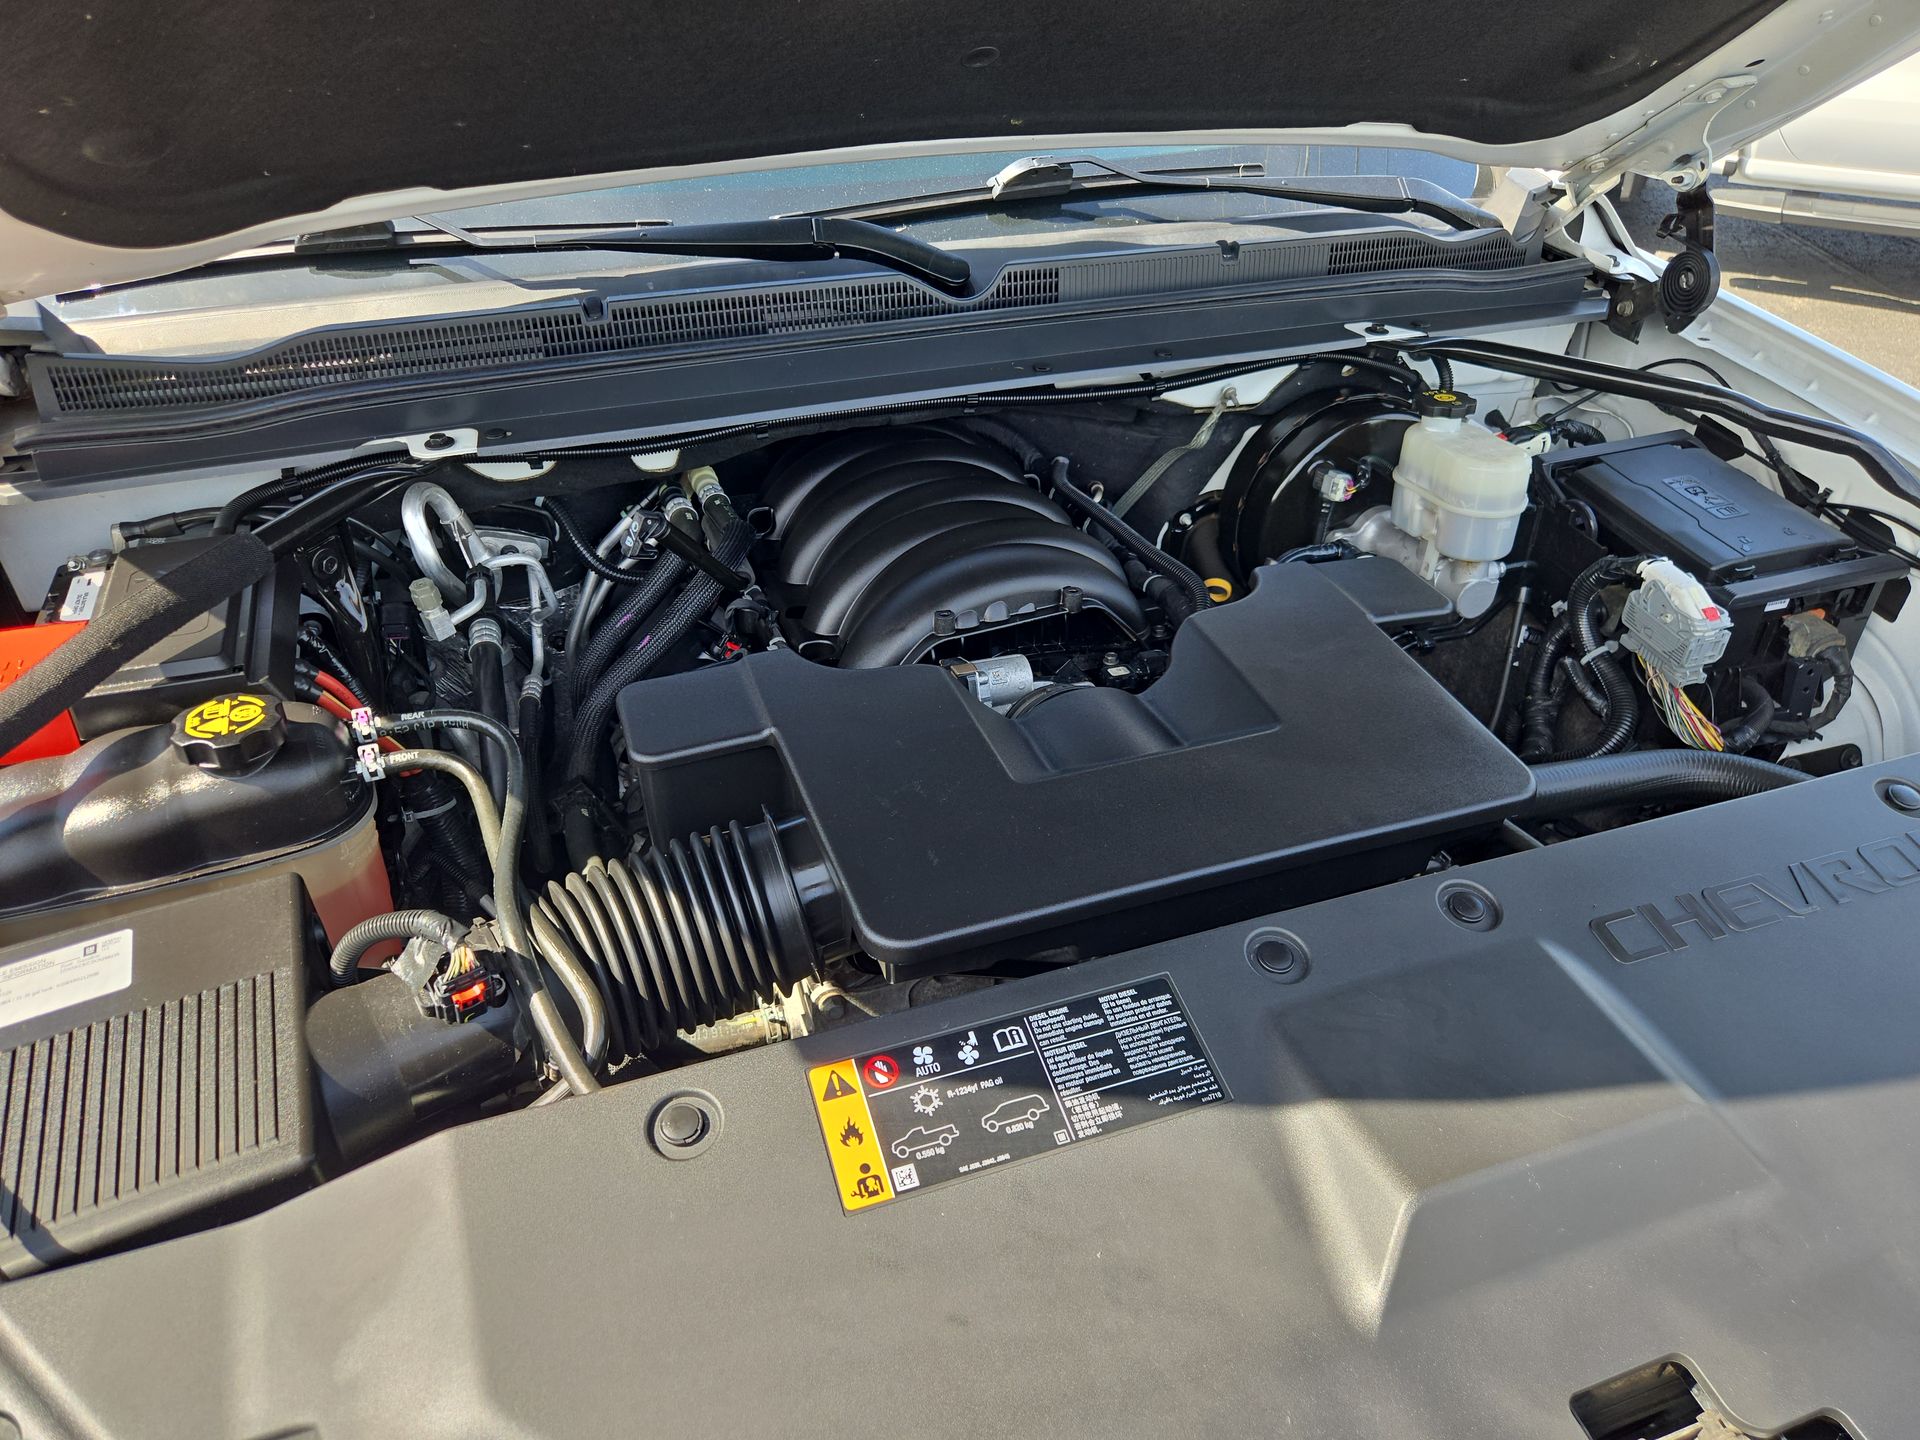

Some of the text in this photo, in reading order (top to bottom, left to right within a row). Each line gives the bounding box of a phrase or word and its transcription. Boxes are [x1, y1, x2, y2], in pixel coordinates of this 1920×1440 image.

[401, 711, 425, 721] REAR
[389, 751, 419, 764] FRONT
[1589, 829, 1920, 965] CHEVRO
[1098, 989, 1137, 1003] MOTOR DIESEL
[1122, 1002, 1140, 1010] fluidos
[1148, 993, 1172, 1004] arranque.
[1028, 1006, 1069, 1022] DIESEL ENGINE
[1114, 1010, 1134, 1020] pueden
[1134, 1004, 1155, 1015] producir
[1036, 1018, 1104, 1040] Immediate engine damage
[1062, 1017, 1083, 1027] starting
[1109, 1016, 1138, 1027] inmediatos
[1115, 1016, 1182, 1039] ДИЗЕЛЬНЫЙ ДВИГАТЕЛЬ
[1132, 1027, 1164, 1041] установлен)
[1163, 1021, 1187, 1032] пусковые
[1043, 1041, 1087, 1057] MOTEUR DIESEL
[1123, 1046, 1148, 1057] жидкости
[1158, 1036, 1185, 1047] холодного
[1129, 1035, 1161, 1048] используйте
[1068, 1056, 1086, 1065] utiliser
[1094, 1048, 1113, 1058] liquide
[1157, 1046, 1174, 1054] может
[1129, 1050, 1186, 1070] вызвать немедленное
[1132, 1055, 1195, 1076] повреждение двигателя.
[916, 1062, 940, 1077] AUTO
[1054, 1063, 1113, 1083] dommages immédiats
[1065, 1078, 1084, 1088] moteur
[1085, 1069, 1113, 1083] pourraient
[946, 1076, 1003, 1098] R-1234yf PAG oil
[1060, 1086, 1082, 1097] résulter.
[1005, 1121, 1034, 1134] 0.820 kg
[935, 1146, 945, 1154] kg
